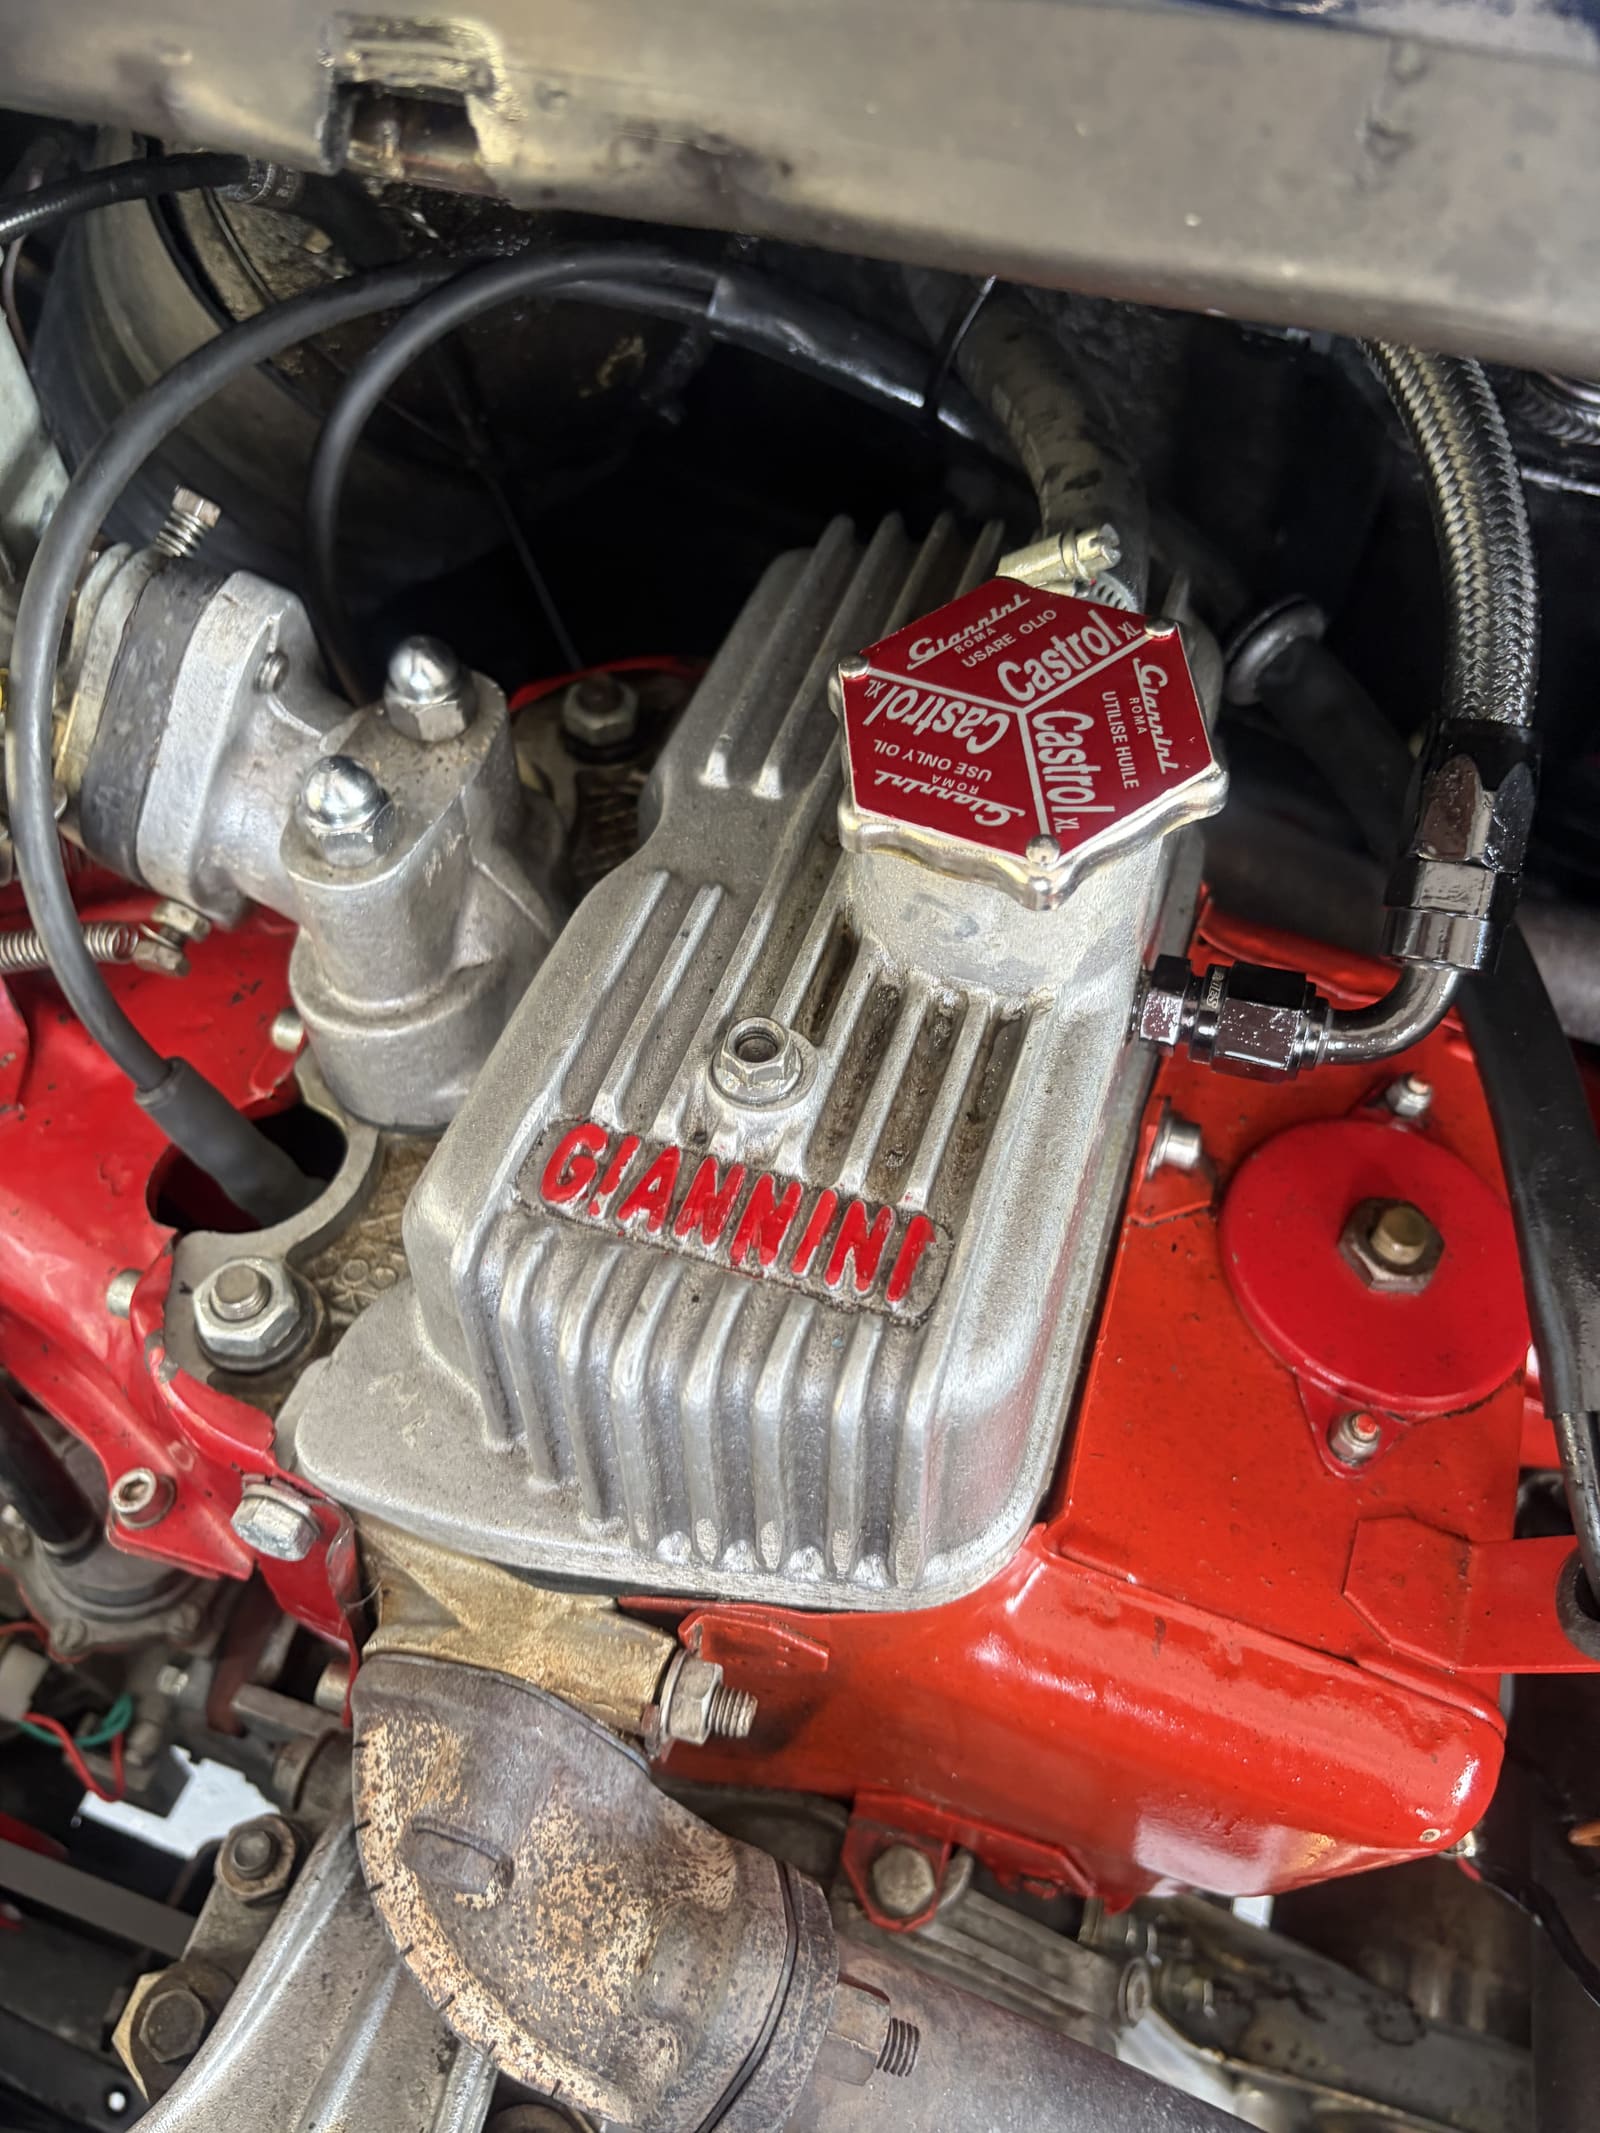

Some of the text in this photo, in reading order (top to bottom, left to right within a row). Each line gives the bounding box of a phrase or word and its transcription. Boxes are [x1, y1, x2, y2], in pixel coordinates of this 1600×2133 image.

[954, 628, 996, 653] ROMA
[961, 608, 1057, 668] USARE OLIO
[997, 609, 1142, 701] Castrol XL
[863, 679, 1009, 755] Castrol XL
[1102, 691, 1139, 789] UTILISE HUILE
[1128, 697, 1145, 735] ROMA
[873, 739, 992, 781] USE ONLY OIL
[932, 774, 979, 794] ROMA
[1033, 711, 1115, 833] Castrol XL
[539, 1121, 936, 1304] GIANNINI
